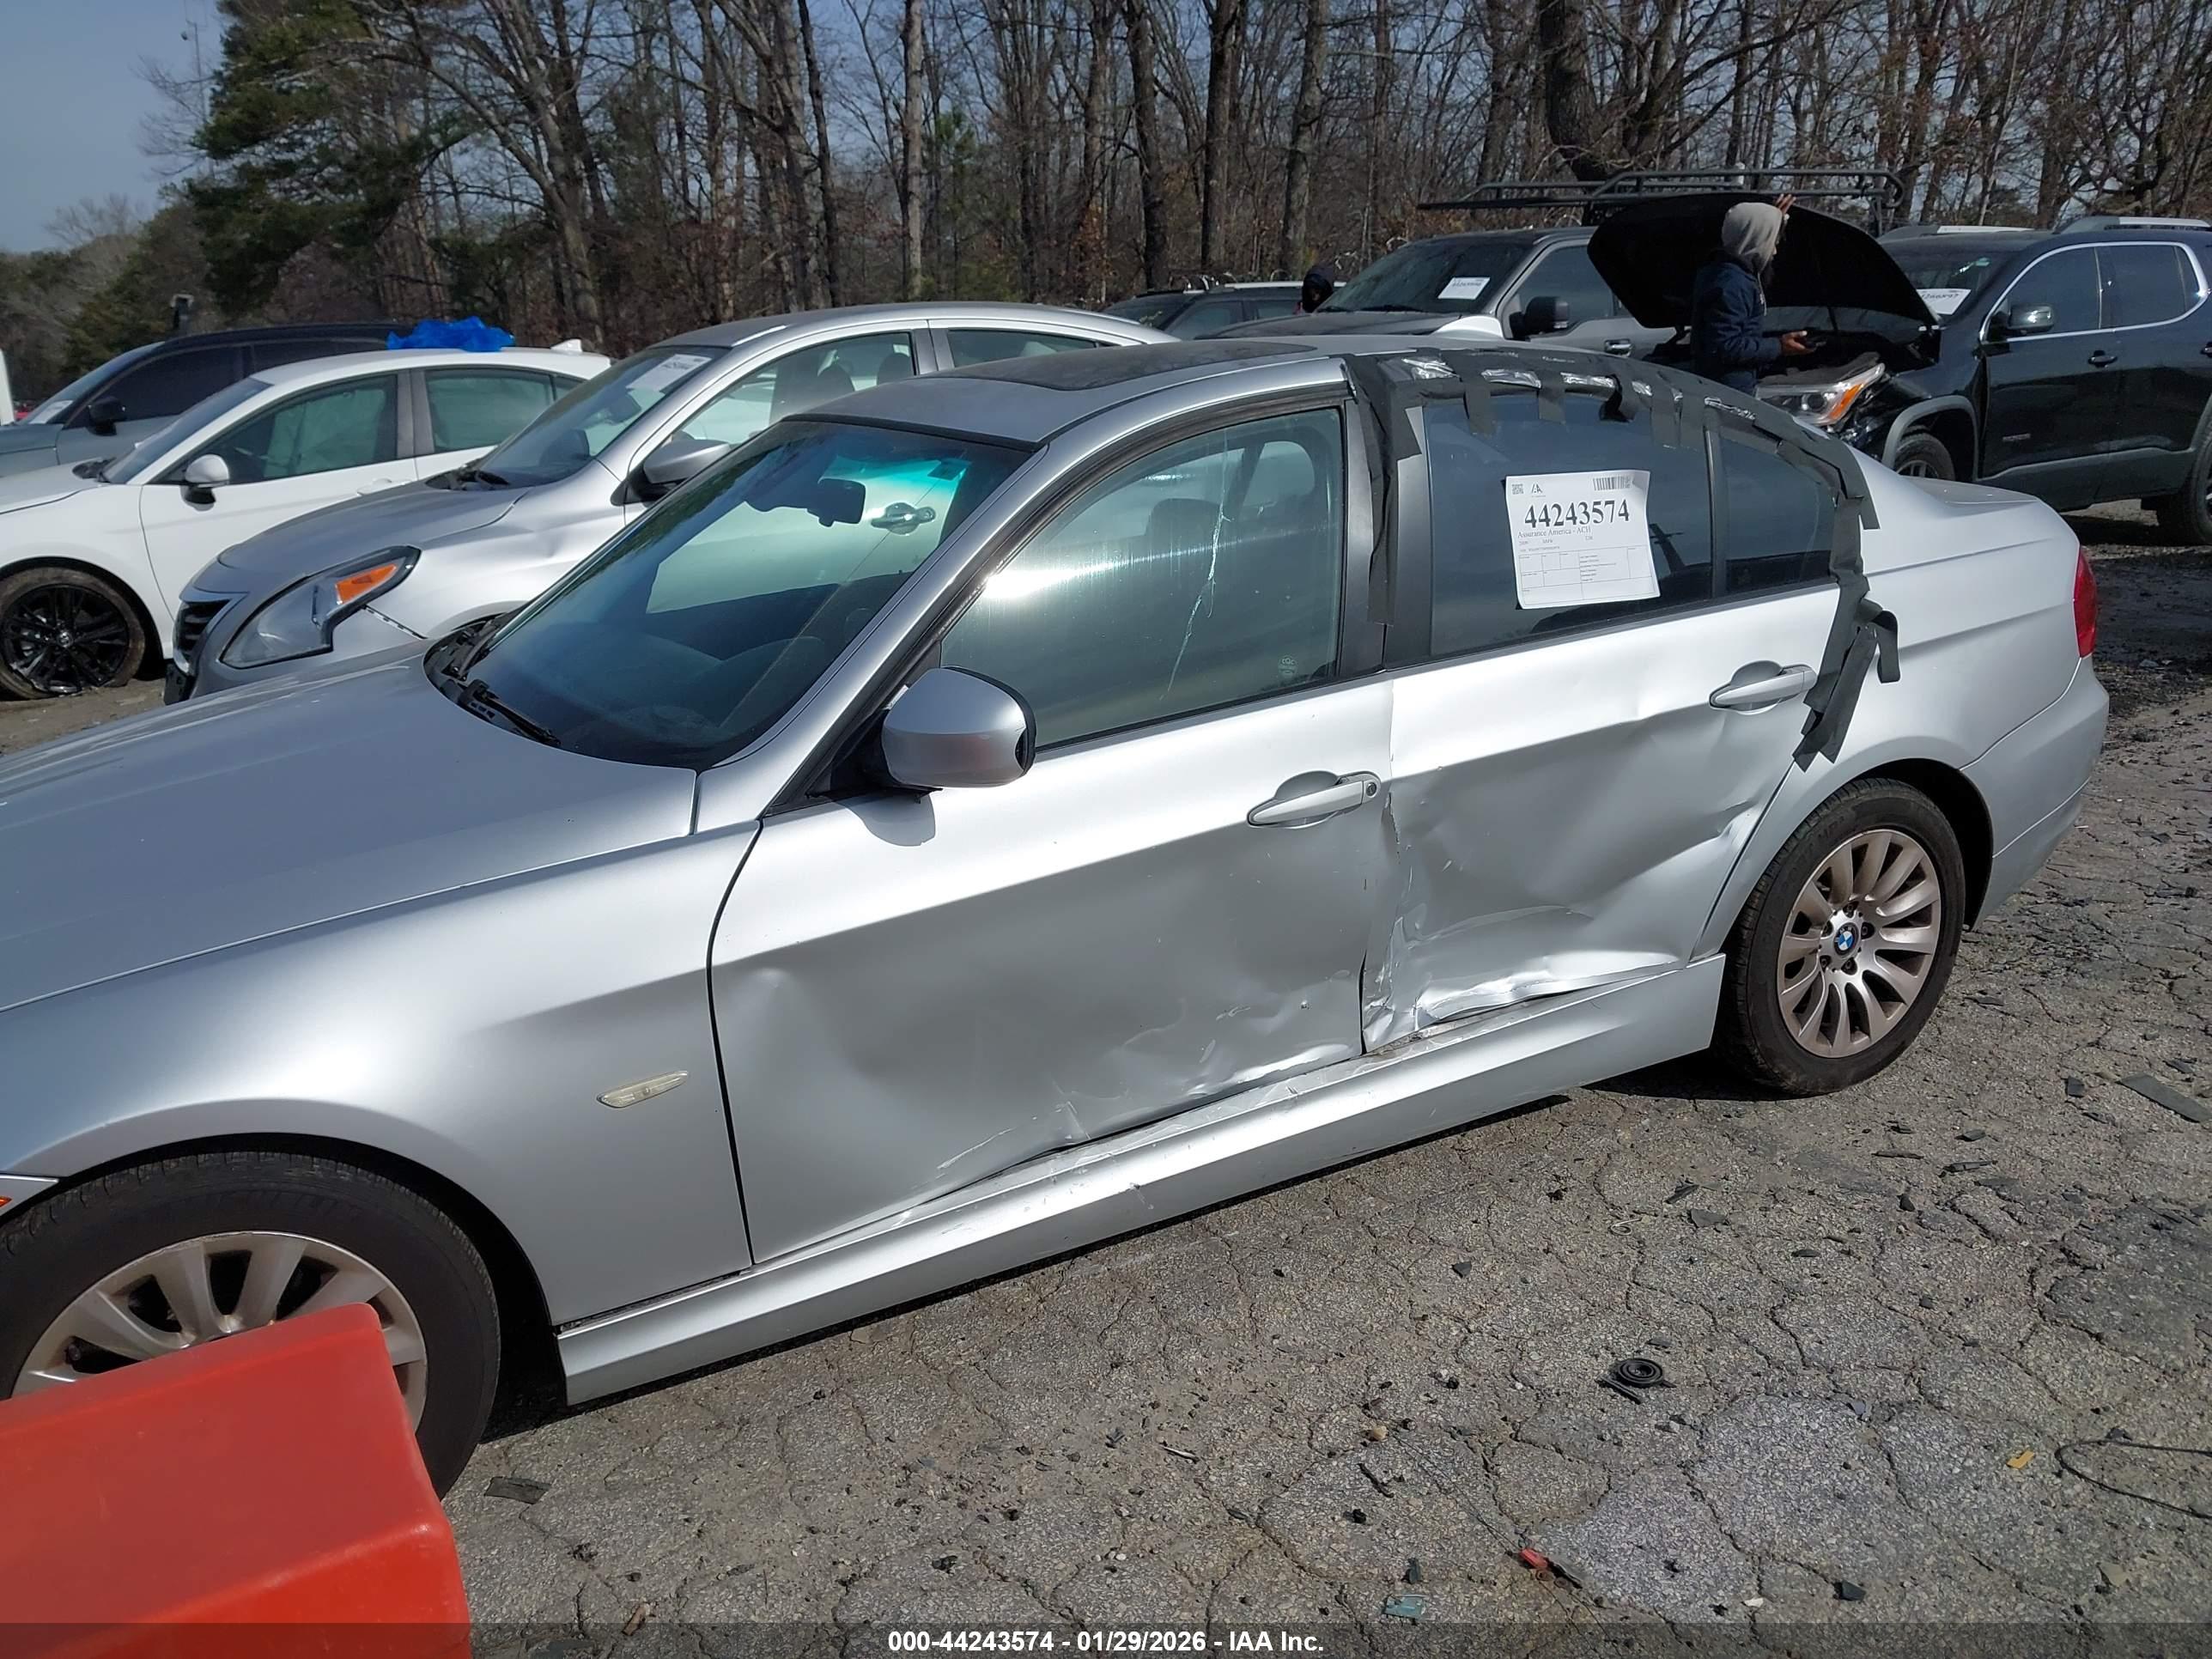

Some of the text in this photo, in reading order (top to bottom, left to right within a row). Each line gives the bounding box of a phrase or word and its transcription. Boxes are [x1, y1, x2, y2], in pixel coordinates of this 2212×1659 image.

[1524, 499, 1629, 528] 44243574
[1518, 529, 1547, 538] Assurance
[1549, 527, 1571, 537] America
[1577, 526, 1591, 534] ACH
